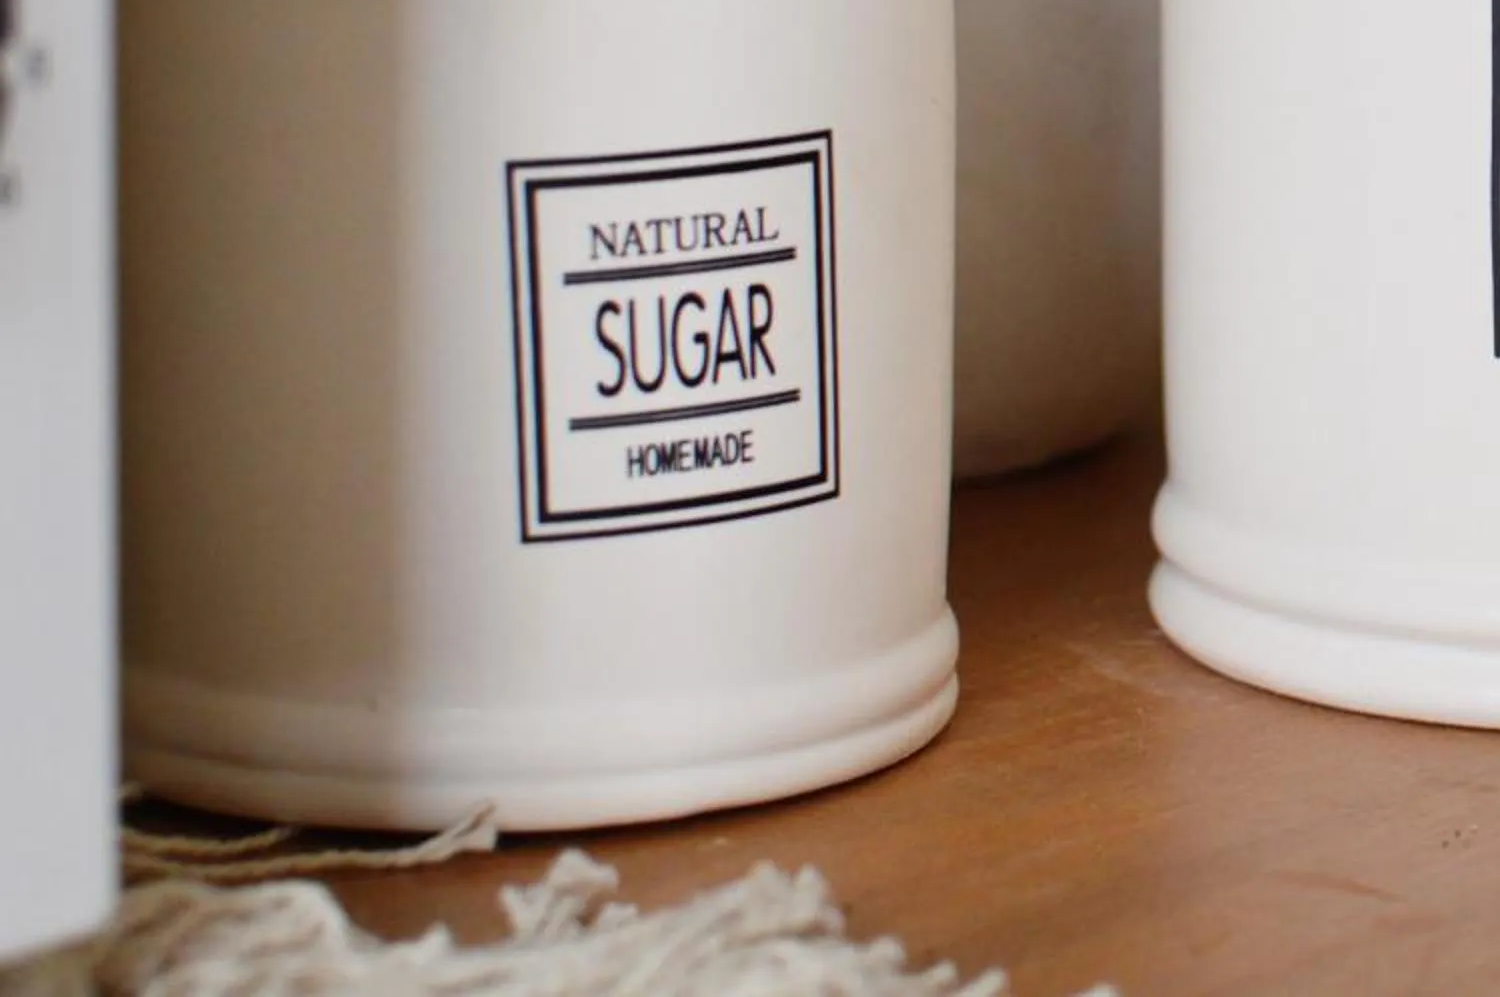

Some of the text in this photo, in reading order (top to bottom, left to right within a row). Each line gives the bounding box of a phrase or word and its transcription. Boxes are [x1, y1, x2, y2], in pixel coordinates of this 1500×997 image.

[589, 207, 780, 260] NATURAL
[595, 283, 776, 397] SUGAR
[627, 430, 754, 478] HOMEMADE
